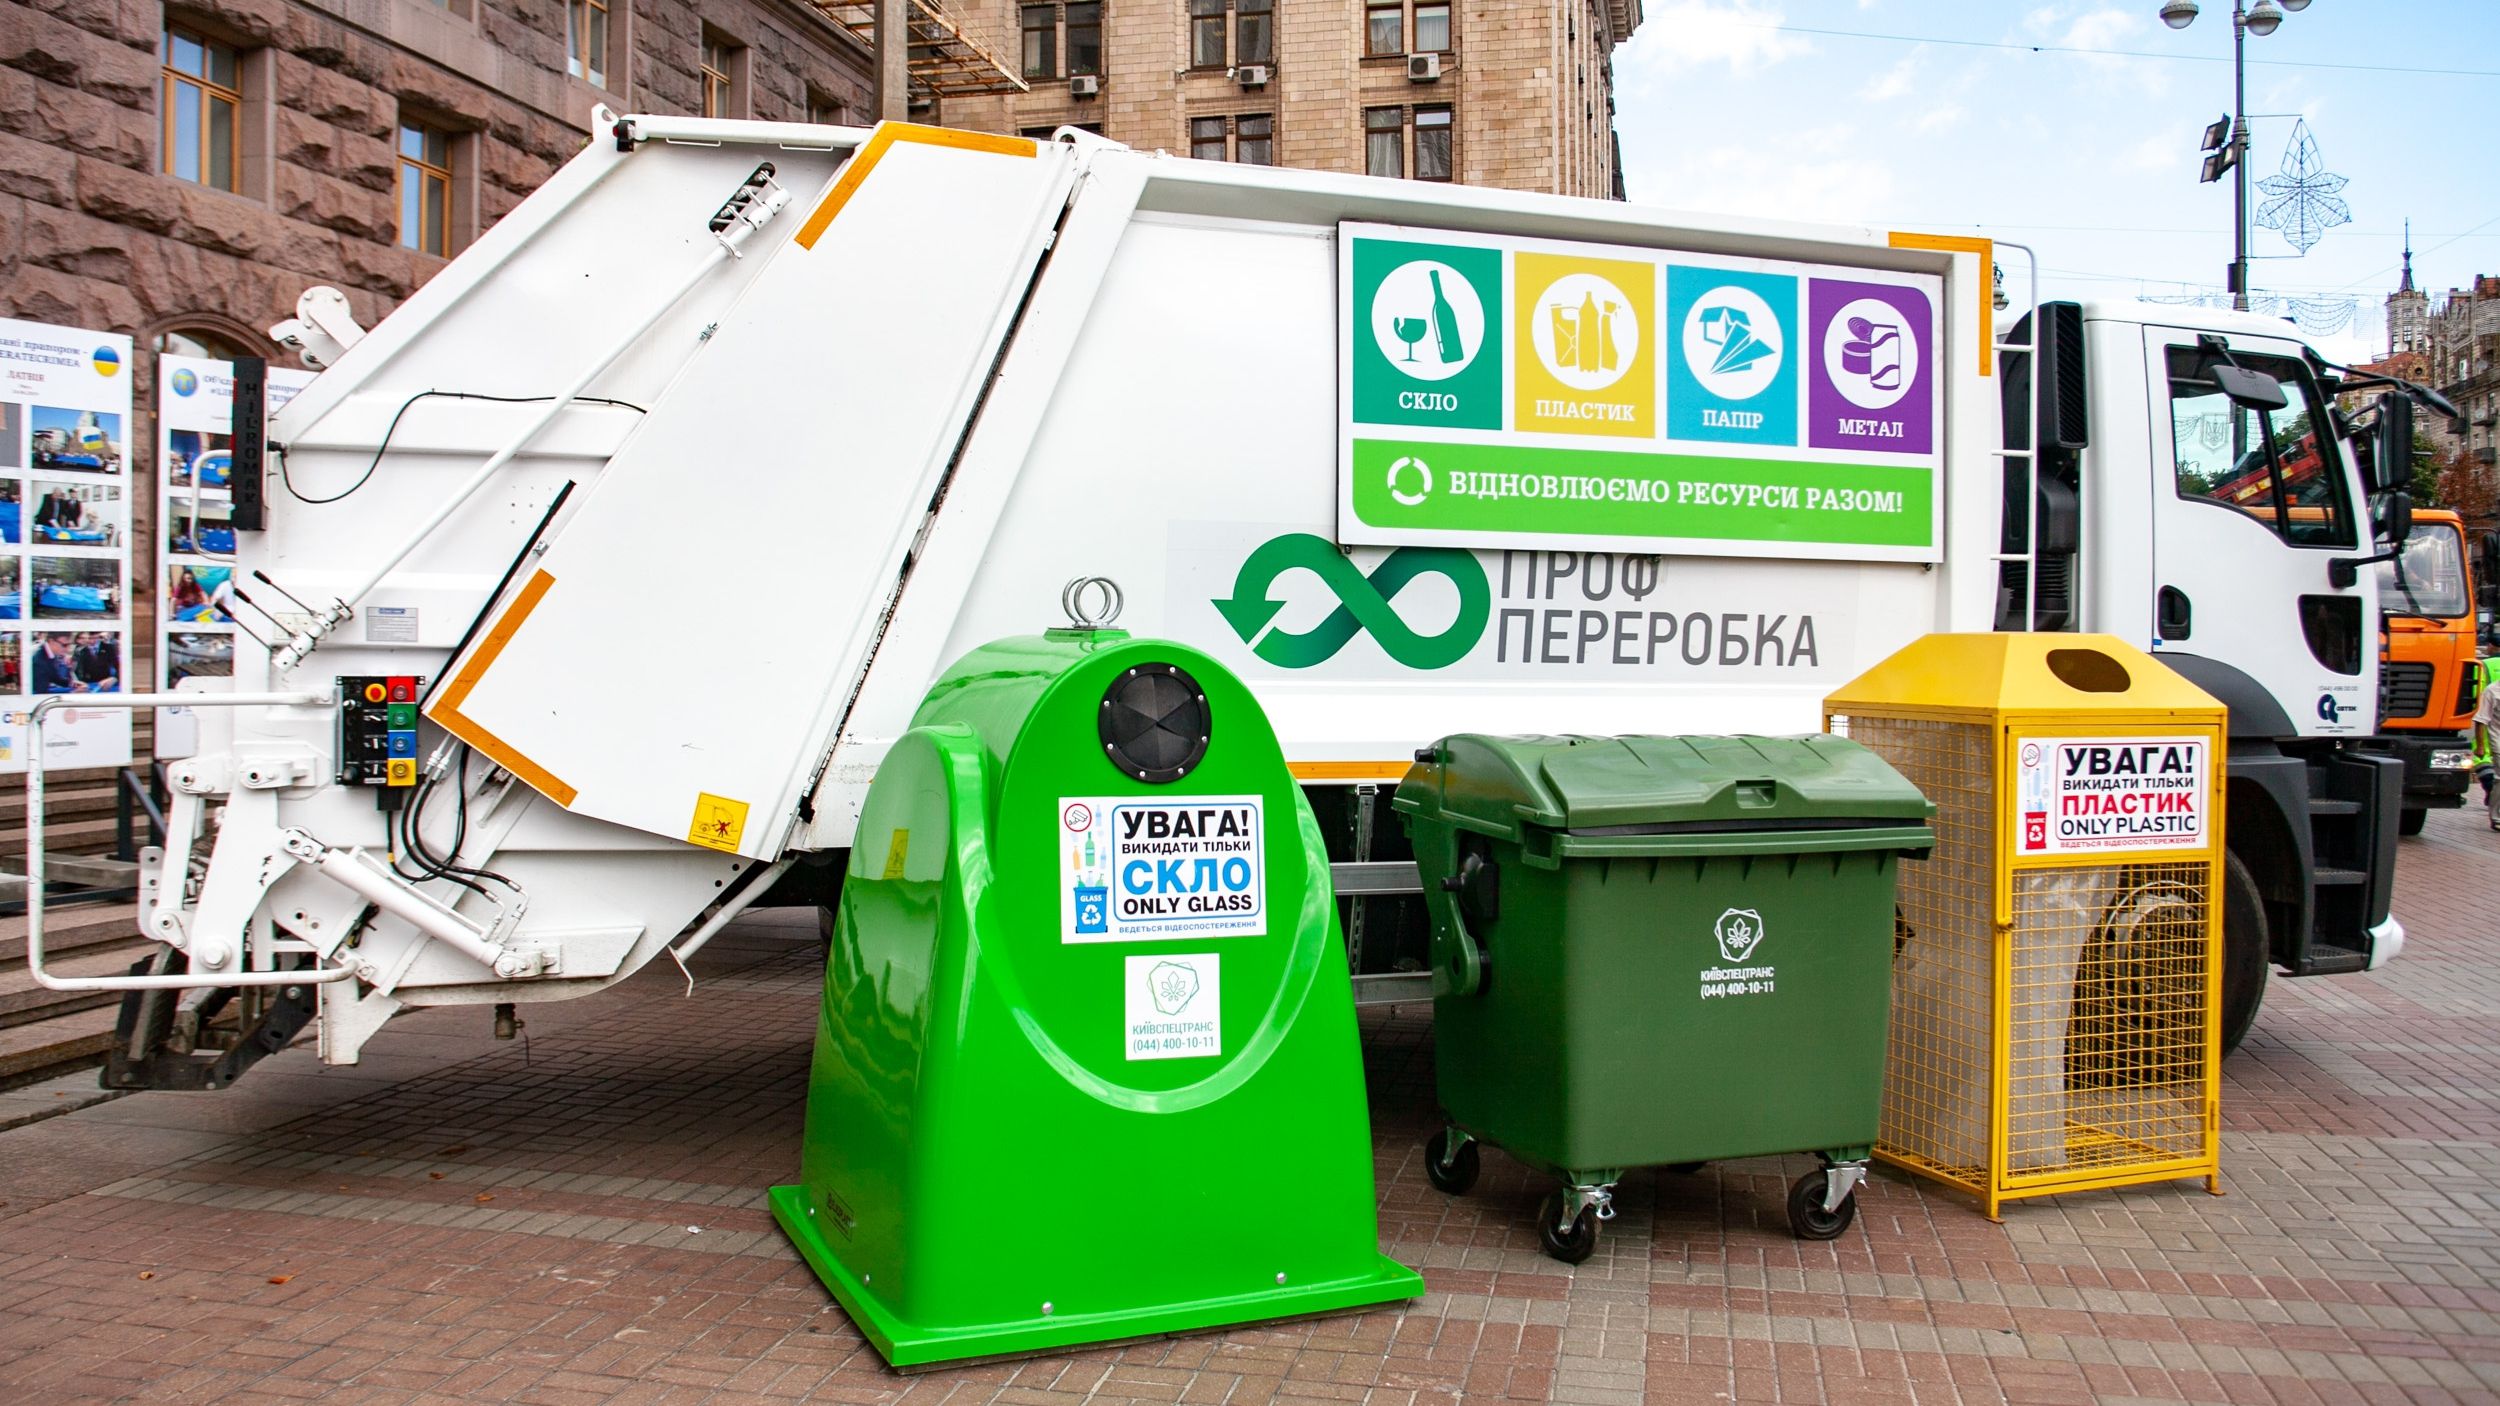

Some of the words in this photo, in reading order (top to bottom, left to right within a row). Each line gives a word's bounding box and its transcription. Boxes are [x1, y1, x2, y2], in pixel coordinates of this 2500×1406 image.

[1398, 391, 1458, 412] СКЛО
[1535, 399, 1636, 422] ПЛАСТИК
[1702, 409, 1764, 429] ПАПІР
[1838, 418, 1904, 438] МЕТАЛ
[1449, 471, 1670, 503] ВІДНОВЛЮЄМО
[1677, 481, 1799, 509] РЕСУРСИ
[1805, 487, 1903, 513] РАЗОМ!
[1501, 550, 1659, 602] ПРОФ
[1497, 608, 1819, 668] ПЕРЕРОБКА
[2064, 746, 2194, 776] УВАГА!
[2063, 778, 2139, 792] ВИКИДАТИ
[2144, 777, 2194, 789] ТІЛЬКИ
[2062, 792, 2194, 816] ПЛАСТИК
[1121, 809, 1250, 840] УВАГА!
[2061, 817, 2112, 836] ONLY
[2117, 815, 2196, 834] PLASTIC
[1121, 842, 1199, 855] ВИКИДАТИ
[1202, 840, 1251, 852] ТІЛЬКИ
[2060, 840, 2101, 849] ВЕДЕТЬСЯ
[2104, 837, 2196, 847] ВІДЕОСПОСТЕРЕЖЕННЯ
[1122, 856, 1252, 895] СКЛО
[1080, 894, 1102, 902] GLASS
[1123, 897, 1181, 915] ONLY
[1187, 894, 1252, 913] GLASS
[1119, 924, 1163, 934] ВЕДЕТЬСЯ
[1165, 921, 1257, 932] ВІДЕОСПОСТЕРЕЖЕННЯ
[1700, 966, 1775, 981] КИЇВСПЕЦТРАНС
[1700, 983, 1726, 1000] (044)
[1727, 981, 1774, 996] 400-10-11
[1132, 1021, 1213, 1035] КИЇВСПЕЦТРАНС
[1133, 1037, 1161, 1053] (044)
[1163, 1036, 1214, 1050] 400-10-11
